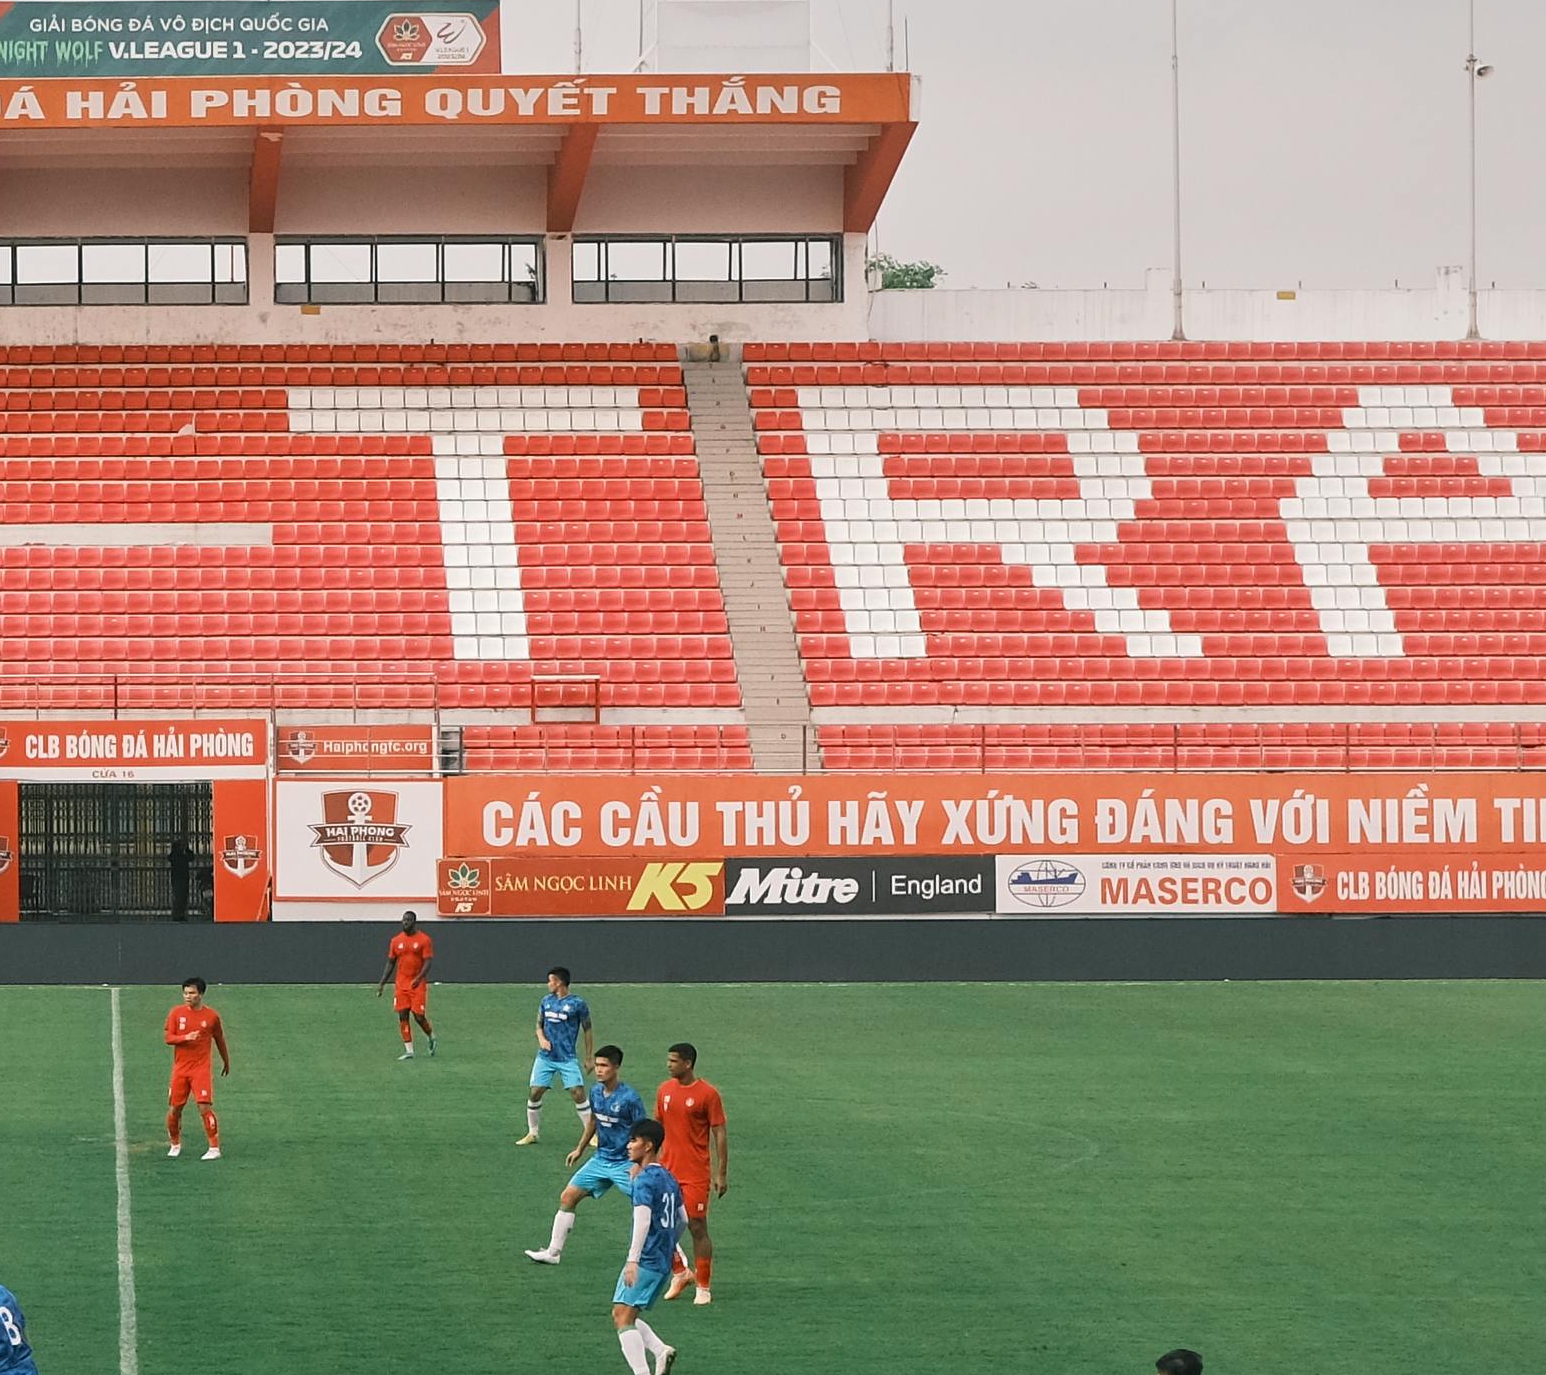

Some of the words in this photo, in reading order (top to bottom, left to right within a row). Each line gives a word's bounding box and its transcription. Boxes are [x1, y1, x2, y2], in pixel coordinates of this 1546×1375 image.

[30, 14, 65, 32] GIẢI
[72, 15, 122, 31] BÓNG
[129, 15, 154, 31] ĐÁ
[160, 15, 185, 31] VÔ
[192, 17, 233, 34] ĐỊCH
[240, 13, 292, 31] QUỐC
[298, 18, 328, 31] GIA
[56, 40, 104, 66] WOLF
[109, 42, 227, 59] V.LEAGUE
[233, 42, 246, 58] 1
[264, 41, 362, 60] 2023/24
[67, 81, 167, 120] HẢI
[191, 81, 402, 118] PHÒNG
[425, 77, 617, 117] QUYẾT
[637, 74, 841, 115] THẮNG
[26, 735, 59, 758] CLB
[66, 730, 116, 758] BÓNG
[122, 730, 148, 758] ĐÁ
[154, 727, 184, 757] HẢI
[190, 728, 253, 757] PHÒNG
[483, 792, 581, 846] CÁC
[601, 786, 699, 846] CẦU
[716, 784, 810, 846] THỦ
[828, 792, 924, 845] HÃY
[942, 790, 1078, 844] XỨNG
[1095, 789, 1233, 843] ĐÁNG
[1250, 789, 1329, 844] VỚI
[1348, 784, 1477, 843] NIỀM
[326, 827, 348, 837] HAI
[351, 827, 395, 837] PHONG
[496, 873, 529, 891] SÂM
[534, 875, 585, 894] NGỌC
[590, 875, 632, 891] LINH
[626, 862, 724, 911] K5
[724, 868, 860, 905] Mitre
[891, 873, 983, 901] England
[1023, 885, 1070, 893] MASERCO
[1100, 876, 1274, 906] MASERCO
[1338, 872, 1369, 900] CLB
[1376, 866, 1423, 900] BÓNG
[1428, 865, 1452, 899] ĐÁ
[1458, 861, 1486, 899] HẢI
[660, 1193, 676, 1229] 31
